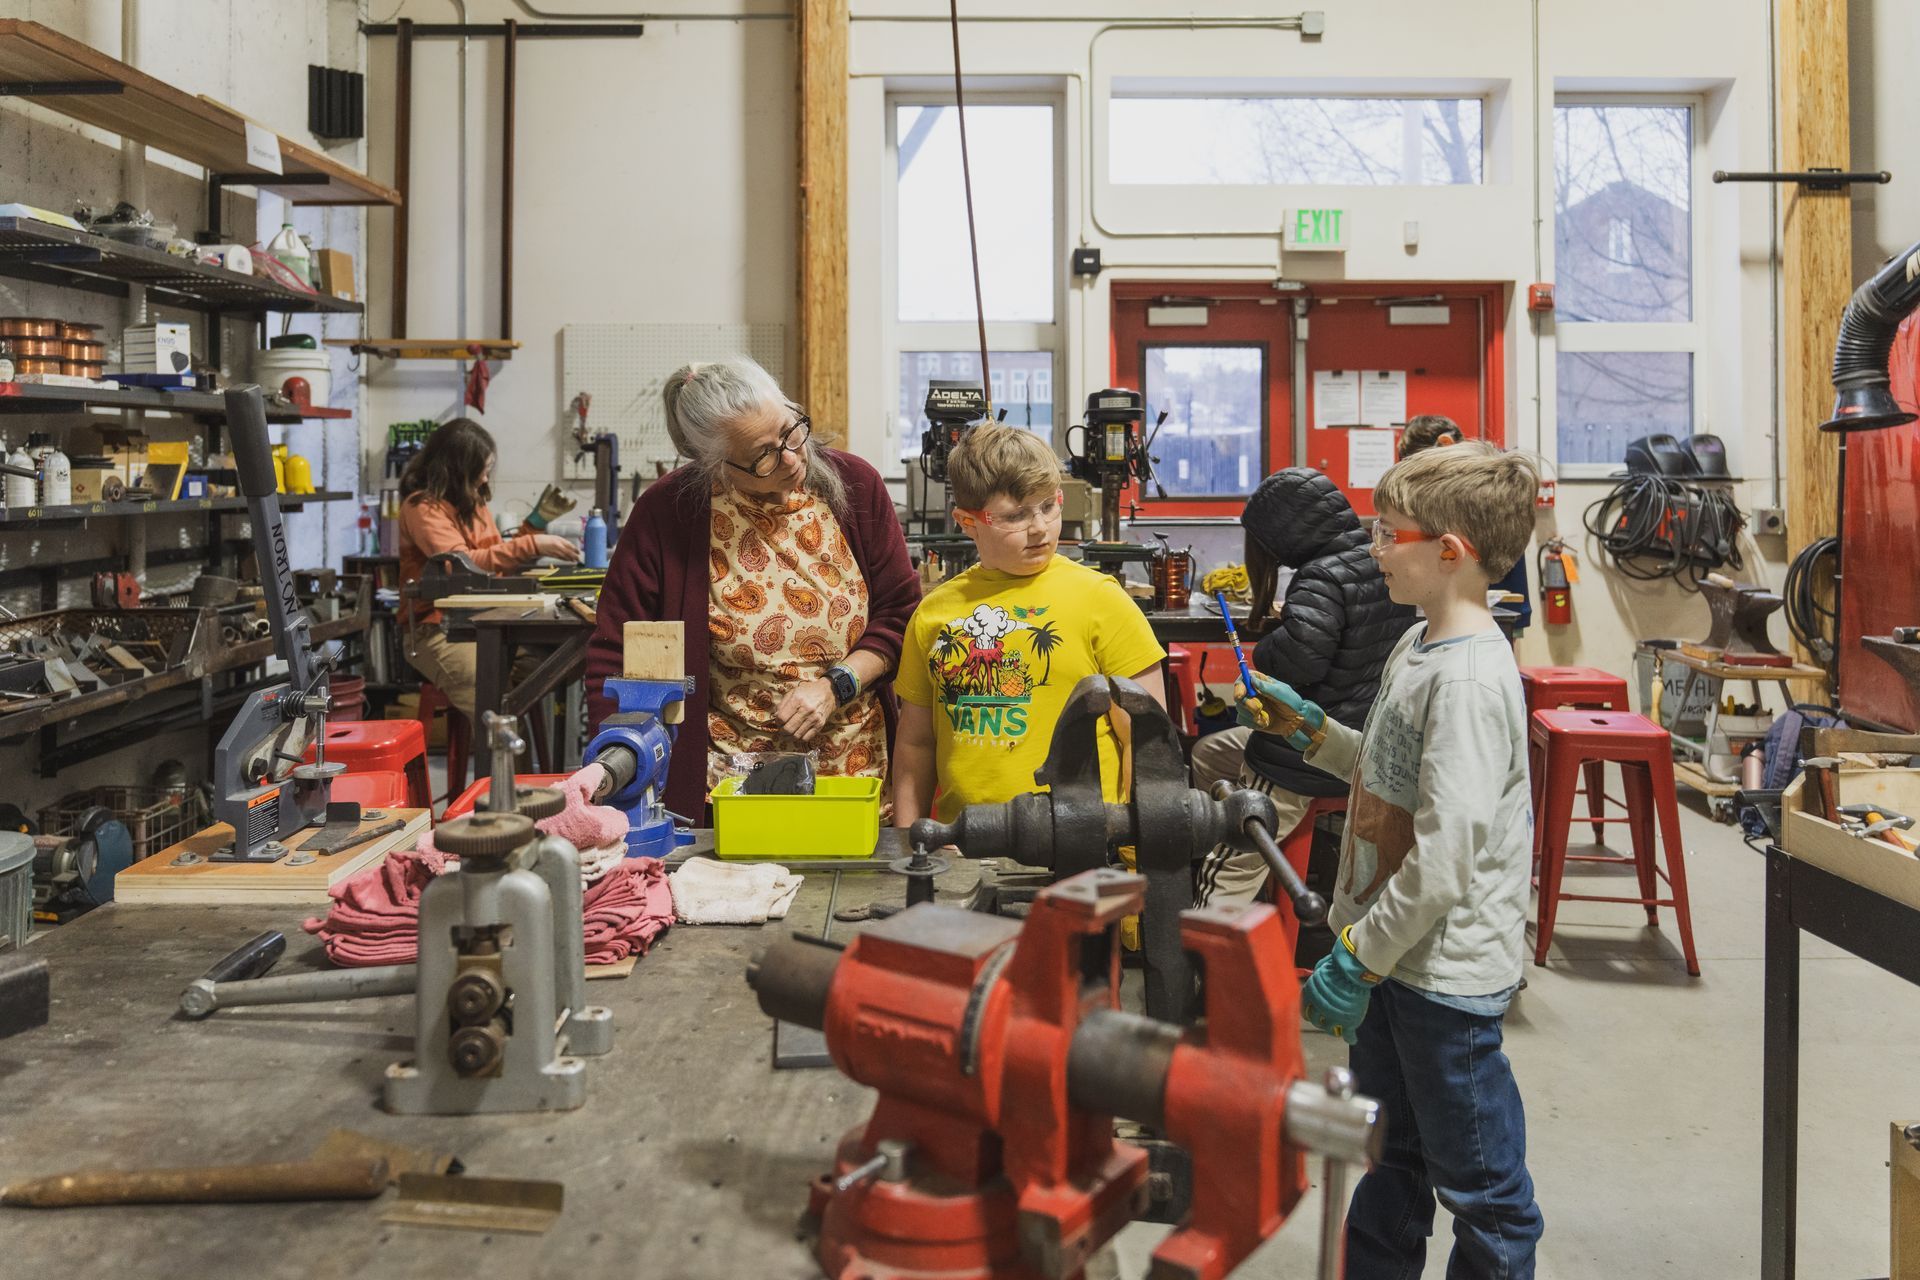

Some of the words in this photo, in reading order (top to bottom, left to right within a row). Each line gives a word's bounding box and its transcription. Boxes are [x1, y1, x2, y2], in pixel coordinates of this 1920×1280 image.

[1296, 209, 1343, 243] EXIT
[941, 391, 981, 400] DELTA
[27, 507, 43, 518] 6011
[282, 581, 297, 616] NO
[1661, 679, 1715, 697] MEAL
[940, 697, 1028, 737] VANS
